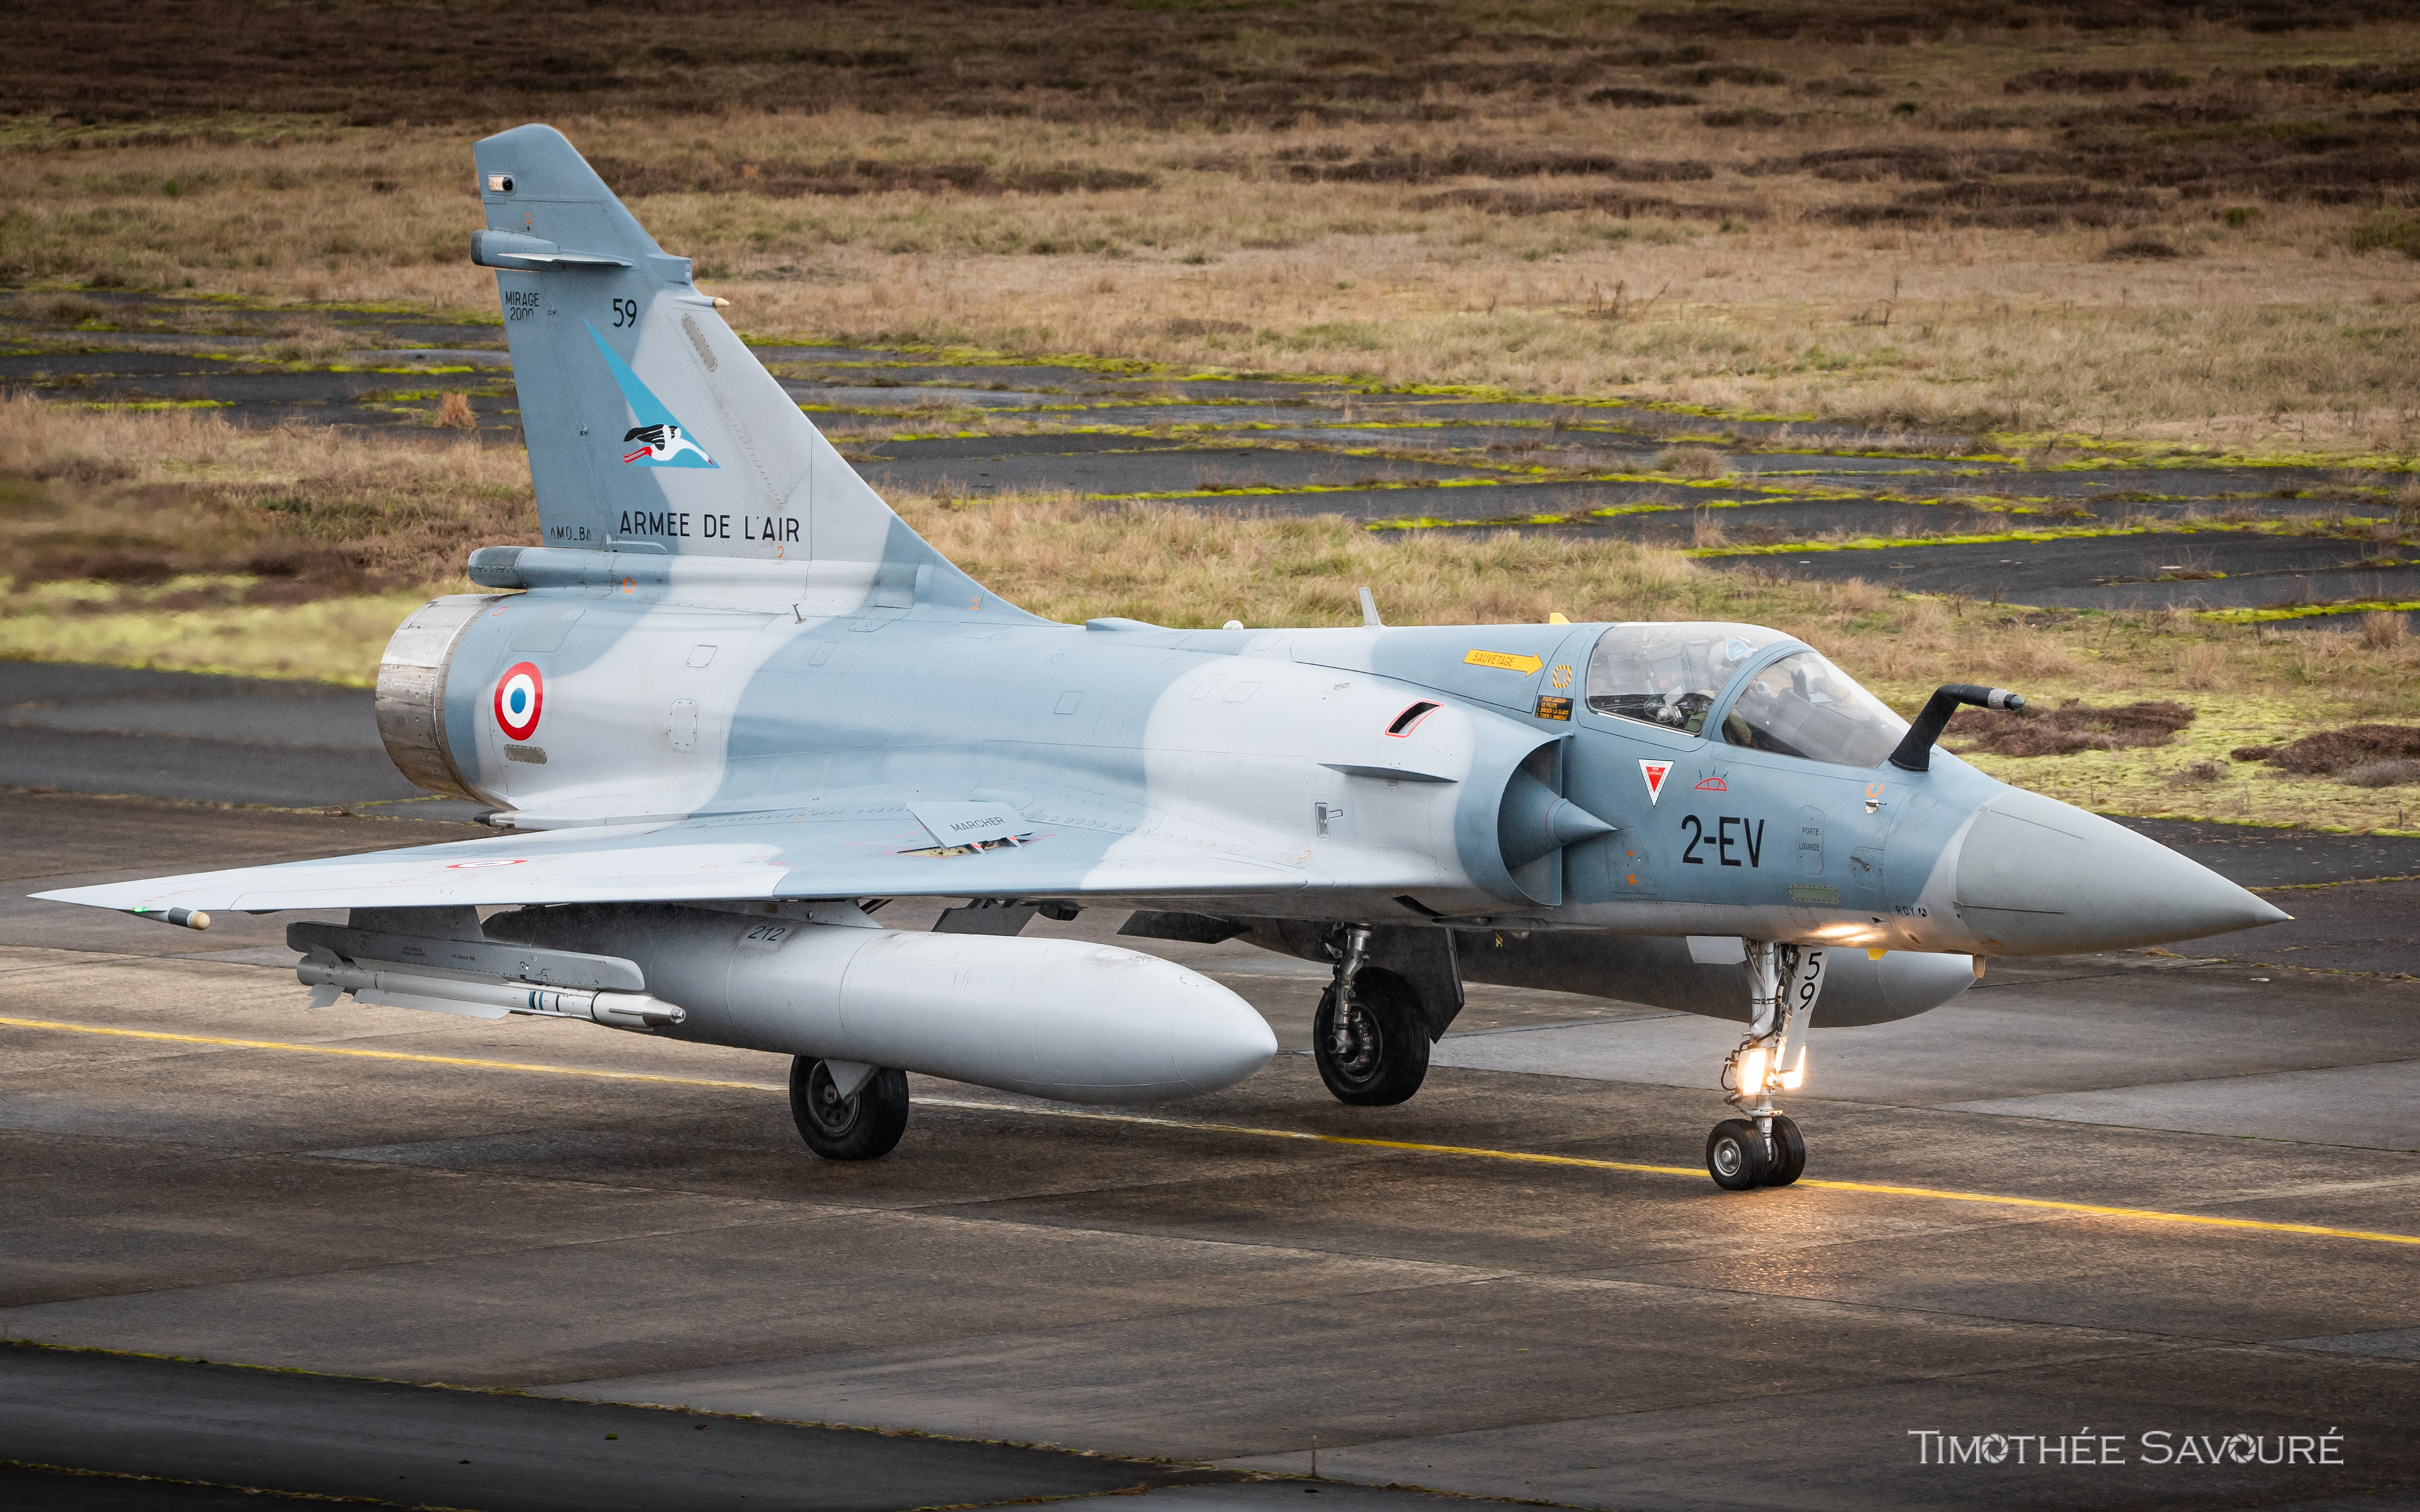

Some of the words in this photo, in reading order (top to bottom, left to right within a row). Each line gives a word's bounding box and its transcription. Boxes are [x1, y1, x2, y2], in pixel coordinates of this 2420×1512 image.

[505, 290, 539, 307] MIRAGE
[613, 298, 637, 328] 59
[619, 510, 690, 537] ARMEE
[703, 513, 730, 539] DE
[745, 515, 800, 542] L'AIR
[1472, 653, 1515, 667] SAUVETAGE
[949, 816, 1006, 832] MARCHER
[1801, 827, 1819, 836] PORTE
[1681, 814, 1765, 868] 2-EV
[1799, 842, 1820, 852] LOURDE
[1895, 905, 1915, 917] RDY
[747, 925, 786, 941] 212
